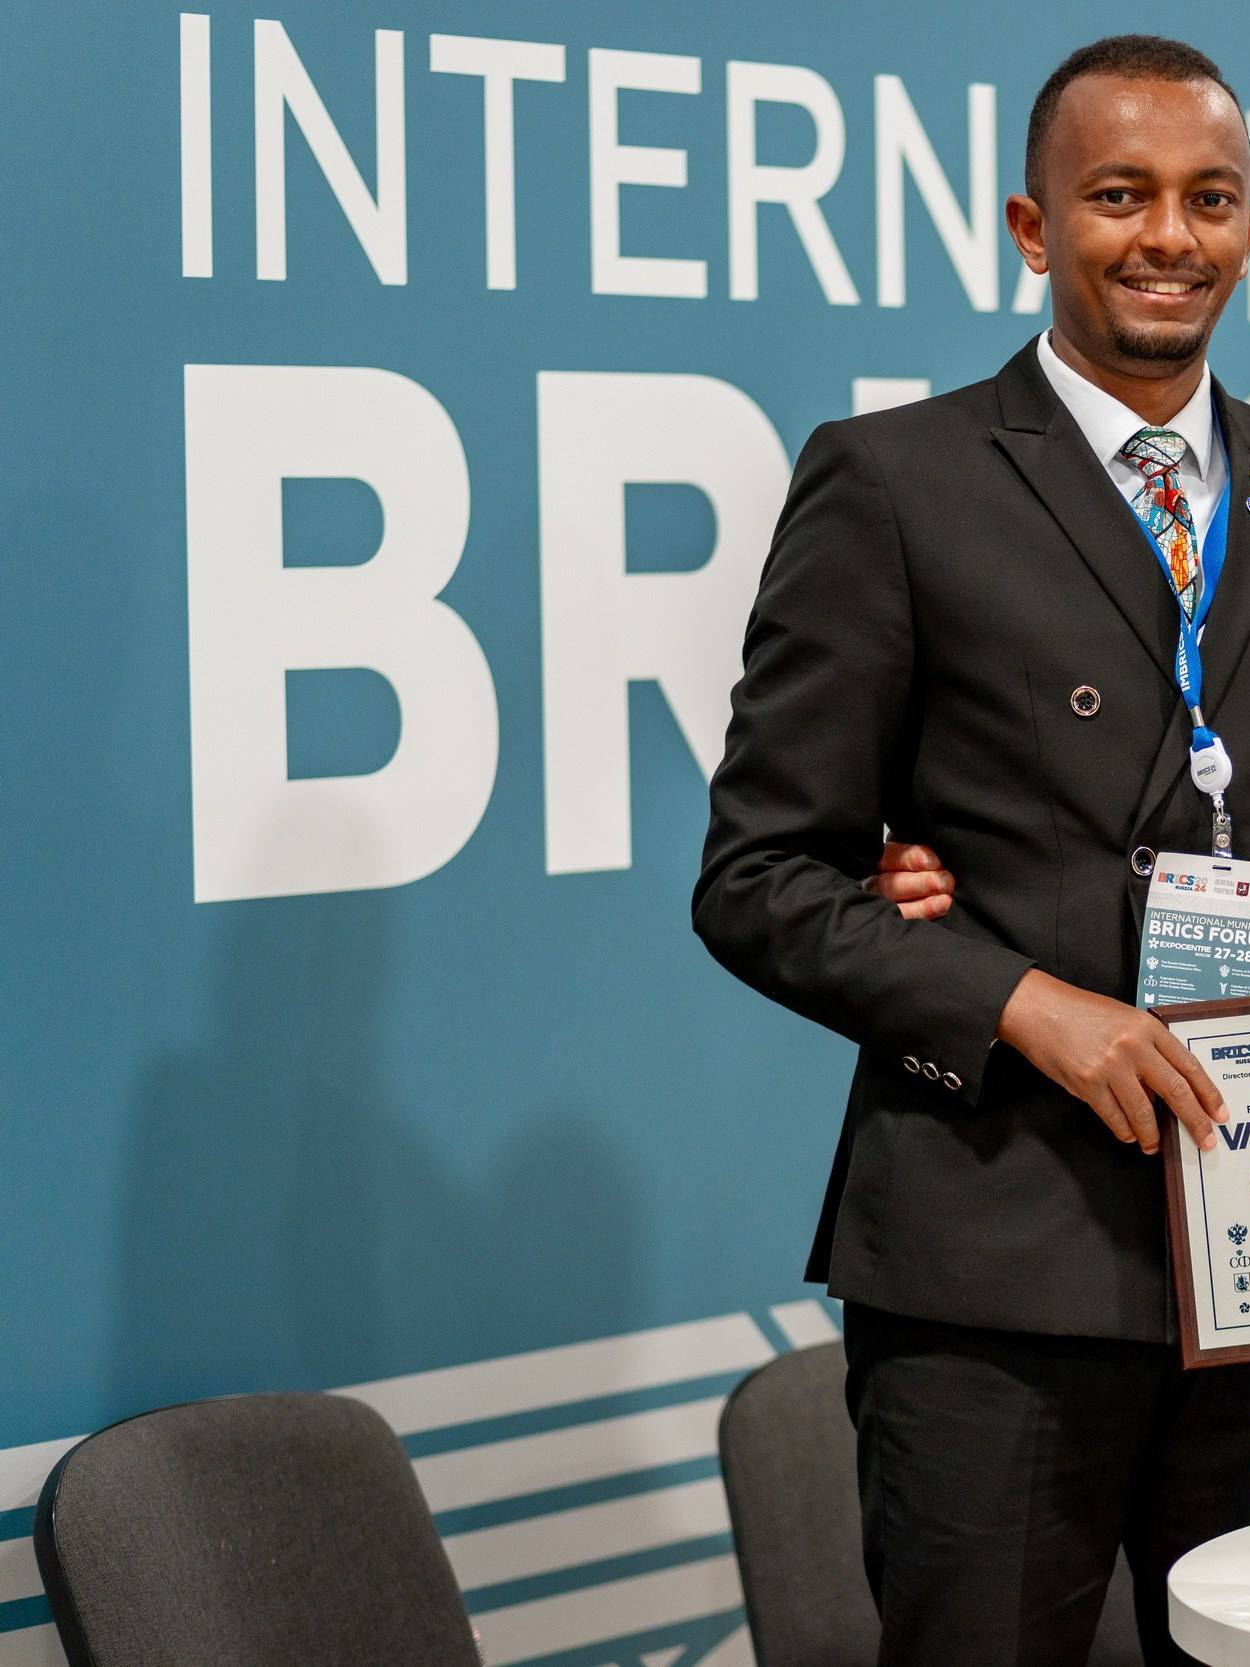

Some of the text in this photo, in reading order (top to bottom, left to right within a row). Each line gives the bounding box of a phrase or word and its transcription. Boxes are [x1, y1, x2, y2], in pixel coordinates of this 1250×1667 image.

[1157, 872, 1195, 886] BRICS
[1214, 878, 1235, 888] GENERAL
[1213, 887, 1235, 896] PARTNER
[1150, 910, 1225, 928] INTERNATIONAL
[1148, 920, 1205, 941] BRICS
[1159, 940, 1212, 953] EXPOCENTRE
